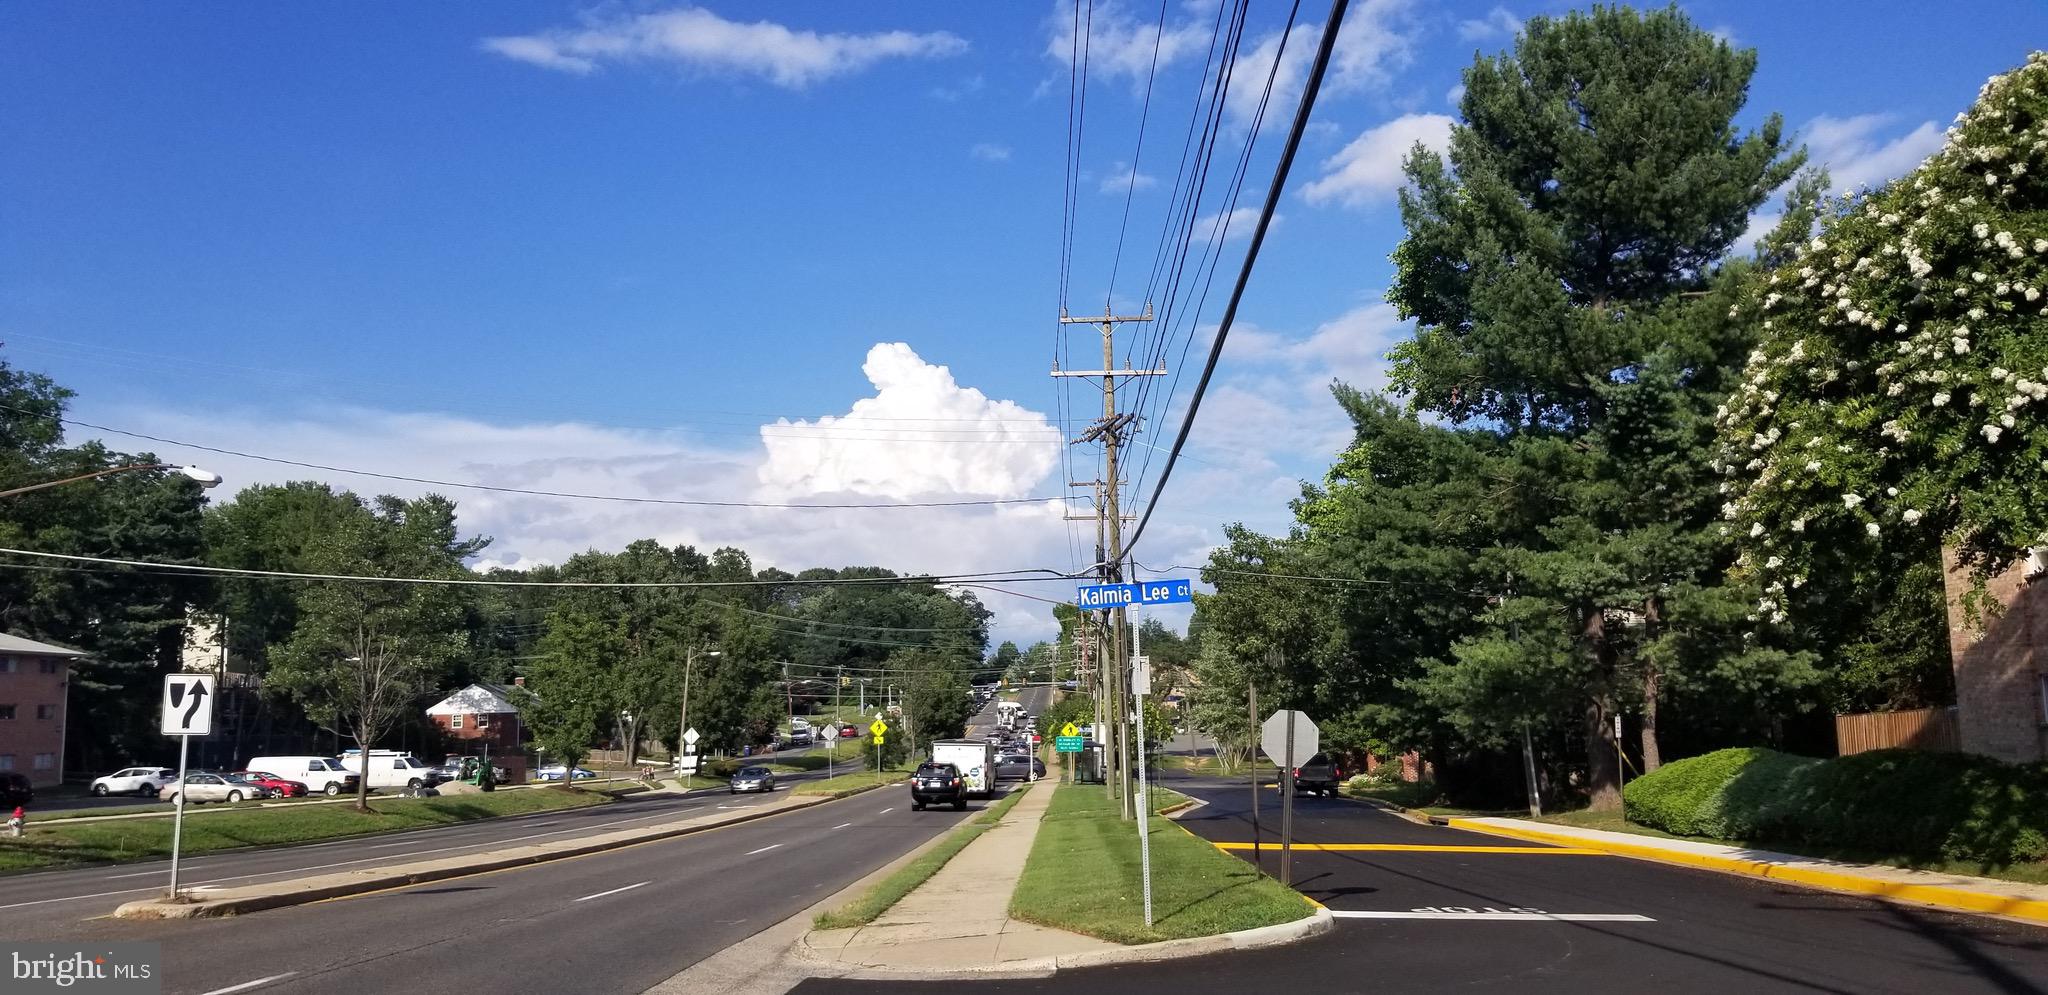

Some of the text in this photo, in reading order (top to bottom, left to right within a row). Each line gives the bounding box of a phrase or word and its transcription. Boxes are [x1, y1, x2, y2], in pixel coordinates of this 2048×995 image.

[1080, 584, 1189, 606] Kalmia Lee Ct
